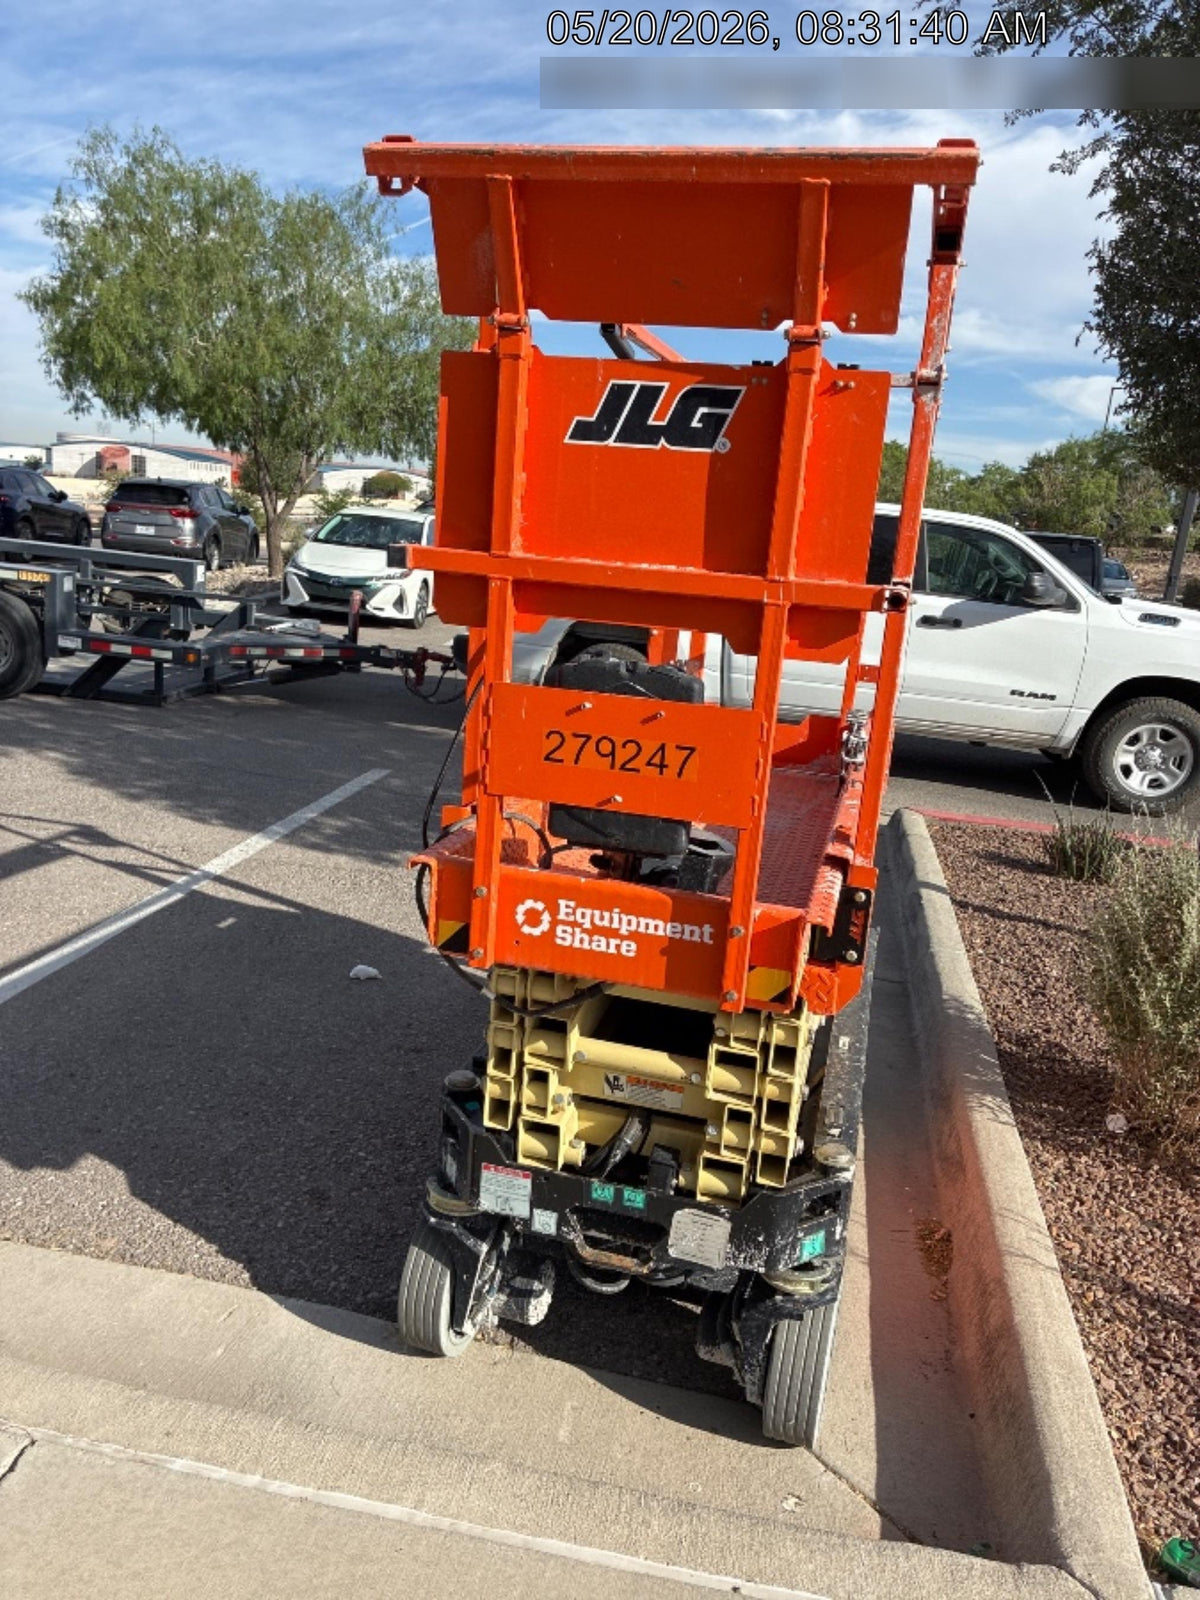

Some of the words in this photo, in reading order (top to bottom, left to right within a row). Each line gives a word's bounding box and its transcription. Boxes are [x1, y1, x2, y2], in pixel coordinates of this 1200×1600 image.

[563, 379, 747, 453] JLG
[543, 730, 697, 779] 279247
[555, 924, 637, 957] Share
[557, 899, 714, 945] Equipment
